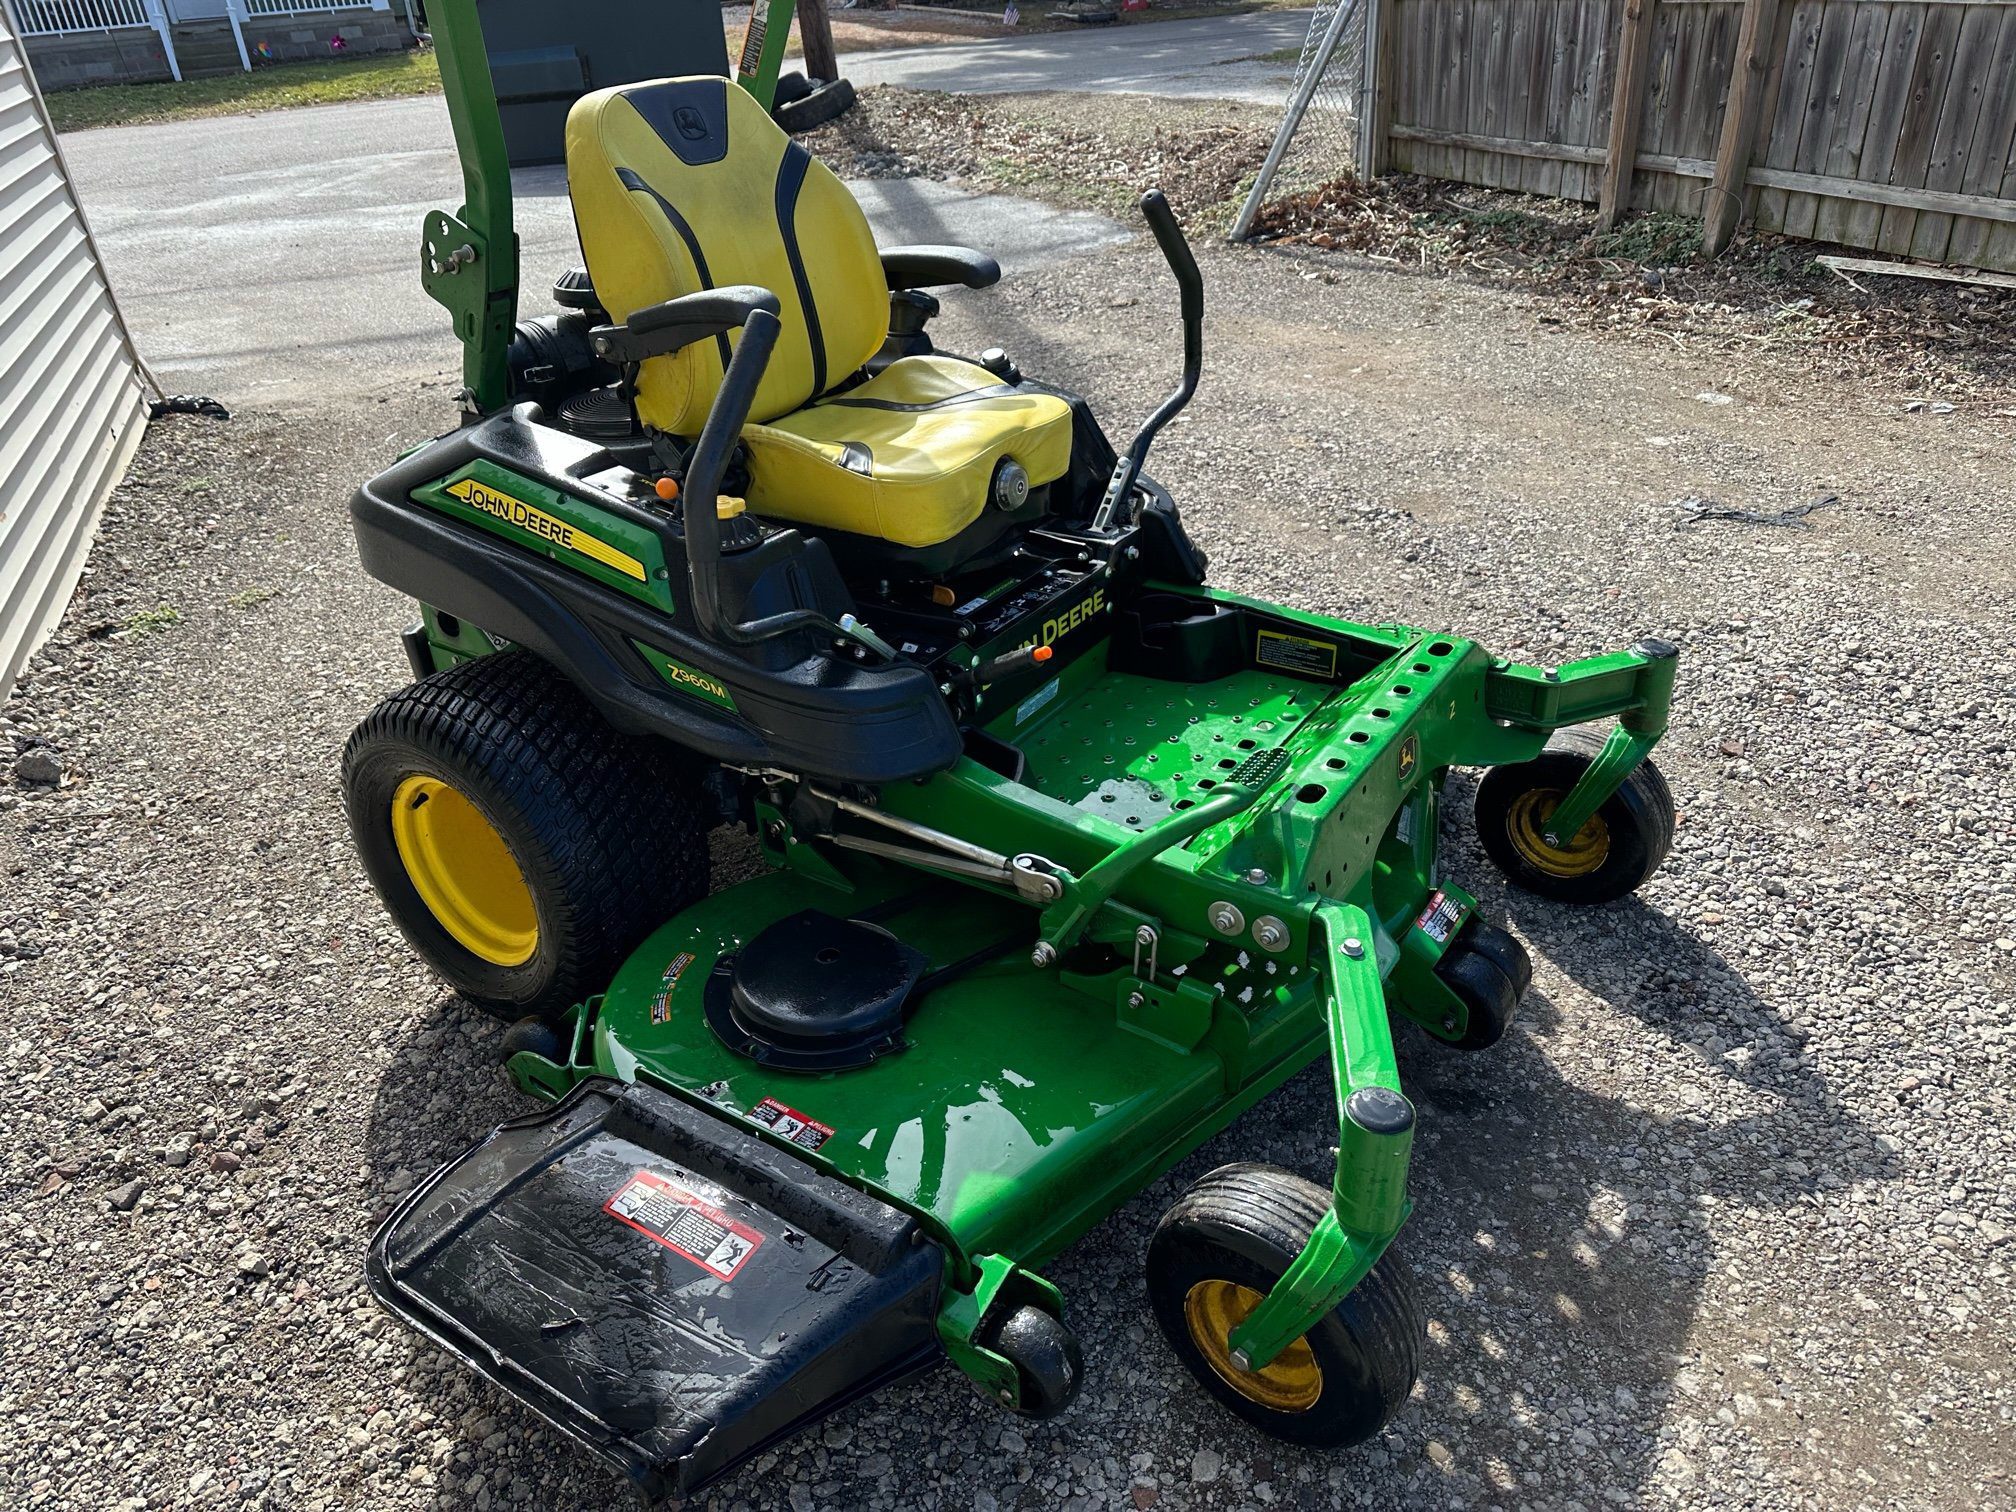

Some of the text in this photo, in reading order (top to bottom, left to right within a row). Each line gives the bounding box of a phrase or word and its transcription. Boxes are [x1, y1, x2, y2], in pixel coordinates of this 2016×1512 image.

[463, 484, 573, 546] JOHN DEERE
[1043, 588, 1105, 645] DEERE
[667, 664, 725, 698] Z960M
[768, 1100, 790, 1113] DANGER
[812, 1122, 835, 1136] PELIGRO
[703, 1207, 734, 1227] PELIGRO
